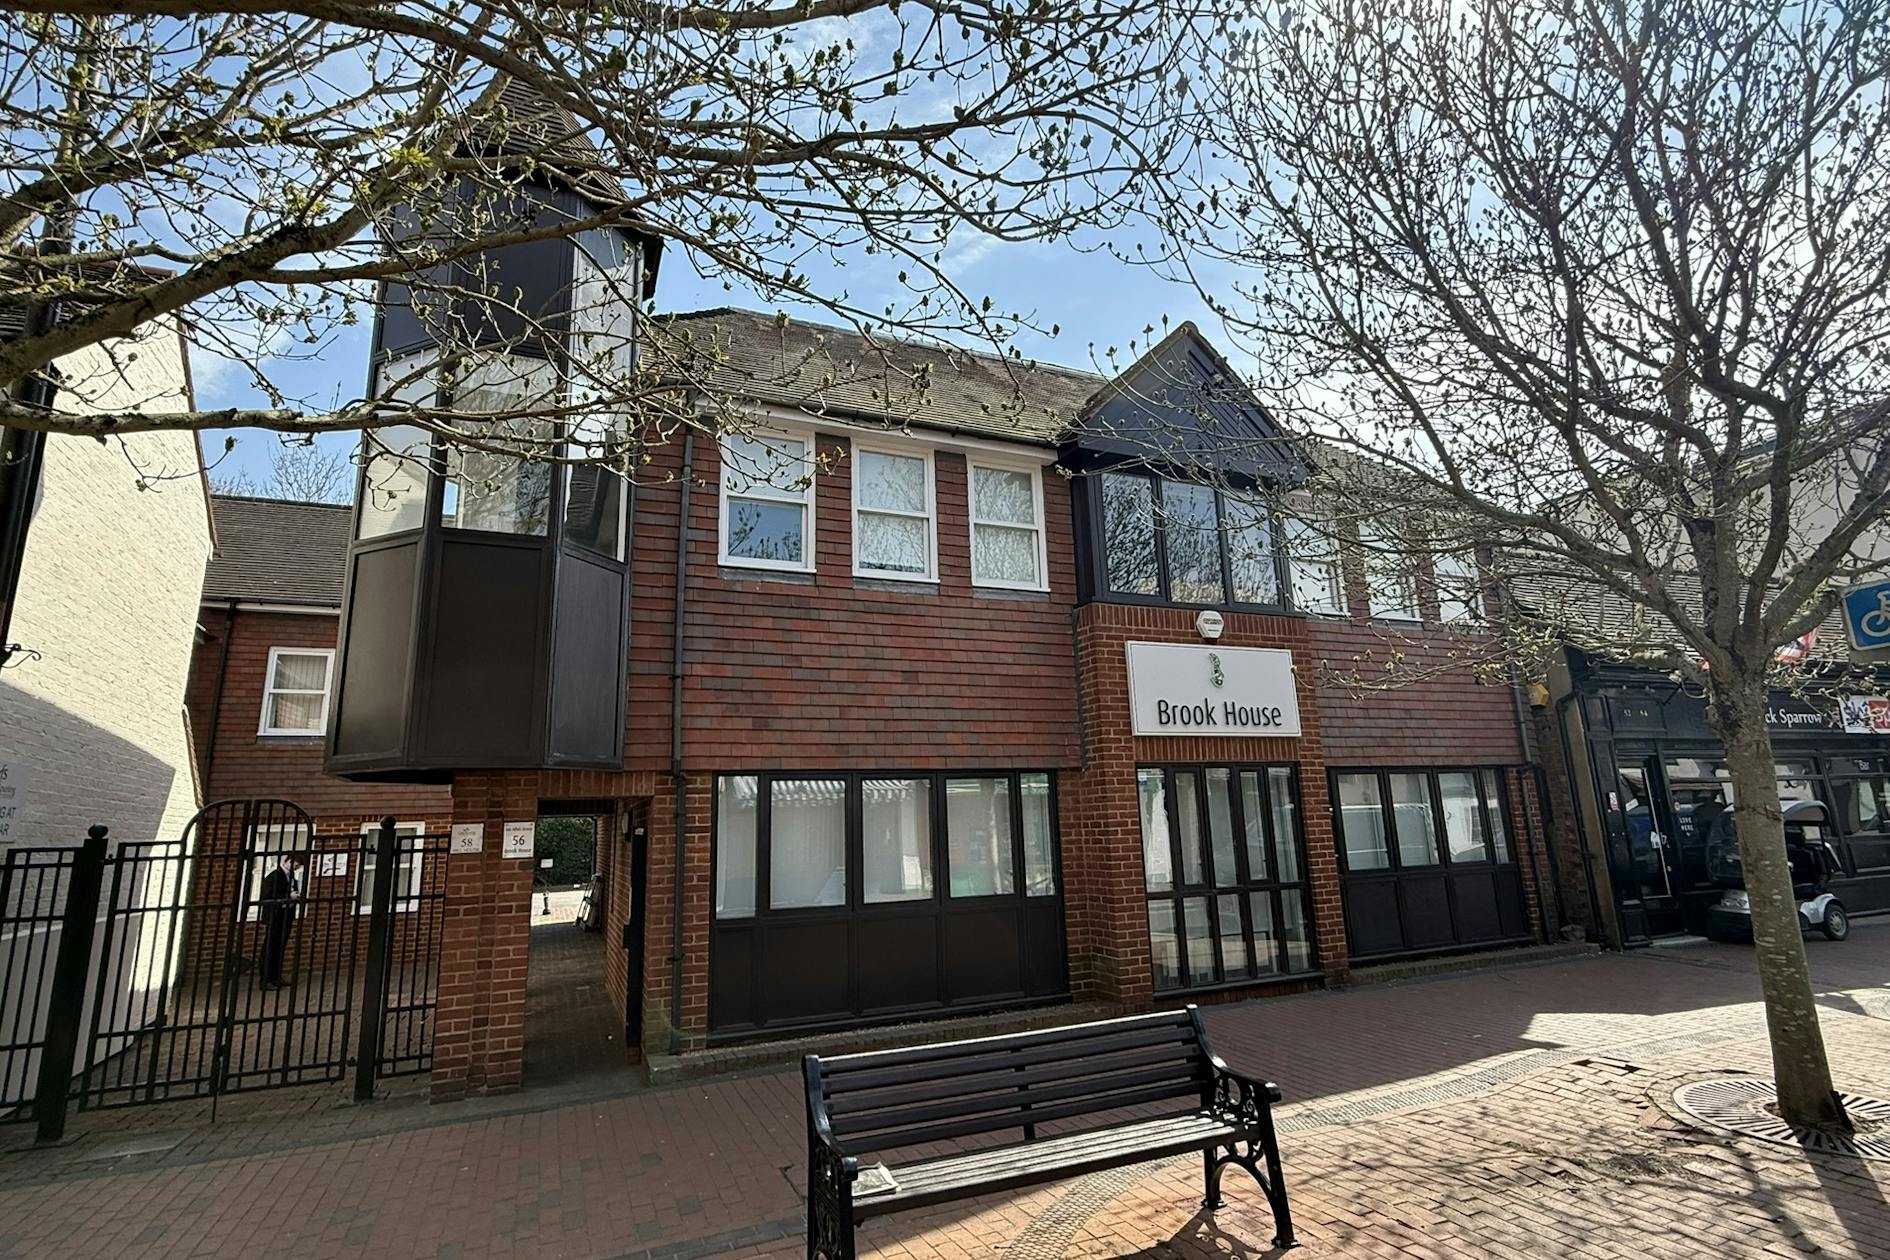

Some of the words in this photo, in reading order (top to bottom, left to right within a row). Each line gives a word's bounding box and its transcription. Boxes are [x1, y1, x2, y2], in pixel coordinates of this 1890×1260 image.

[1157, 698, 1217, 726] Brook
[1224, 701, 1282, 726] House
[1779, 708, 1822, 728] Sparrow
[460, 838, 473, 847] 58
[512, 834, 525, 846] 56
